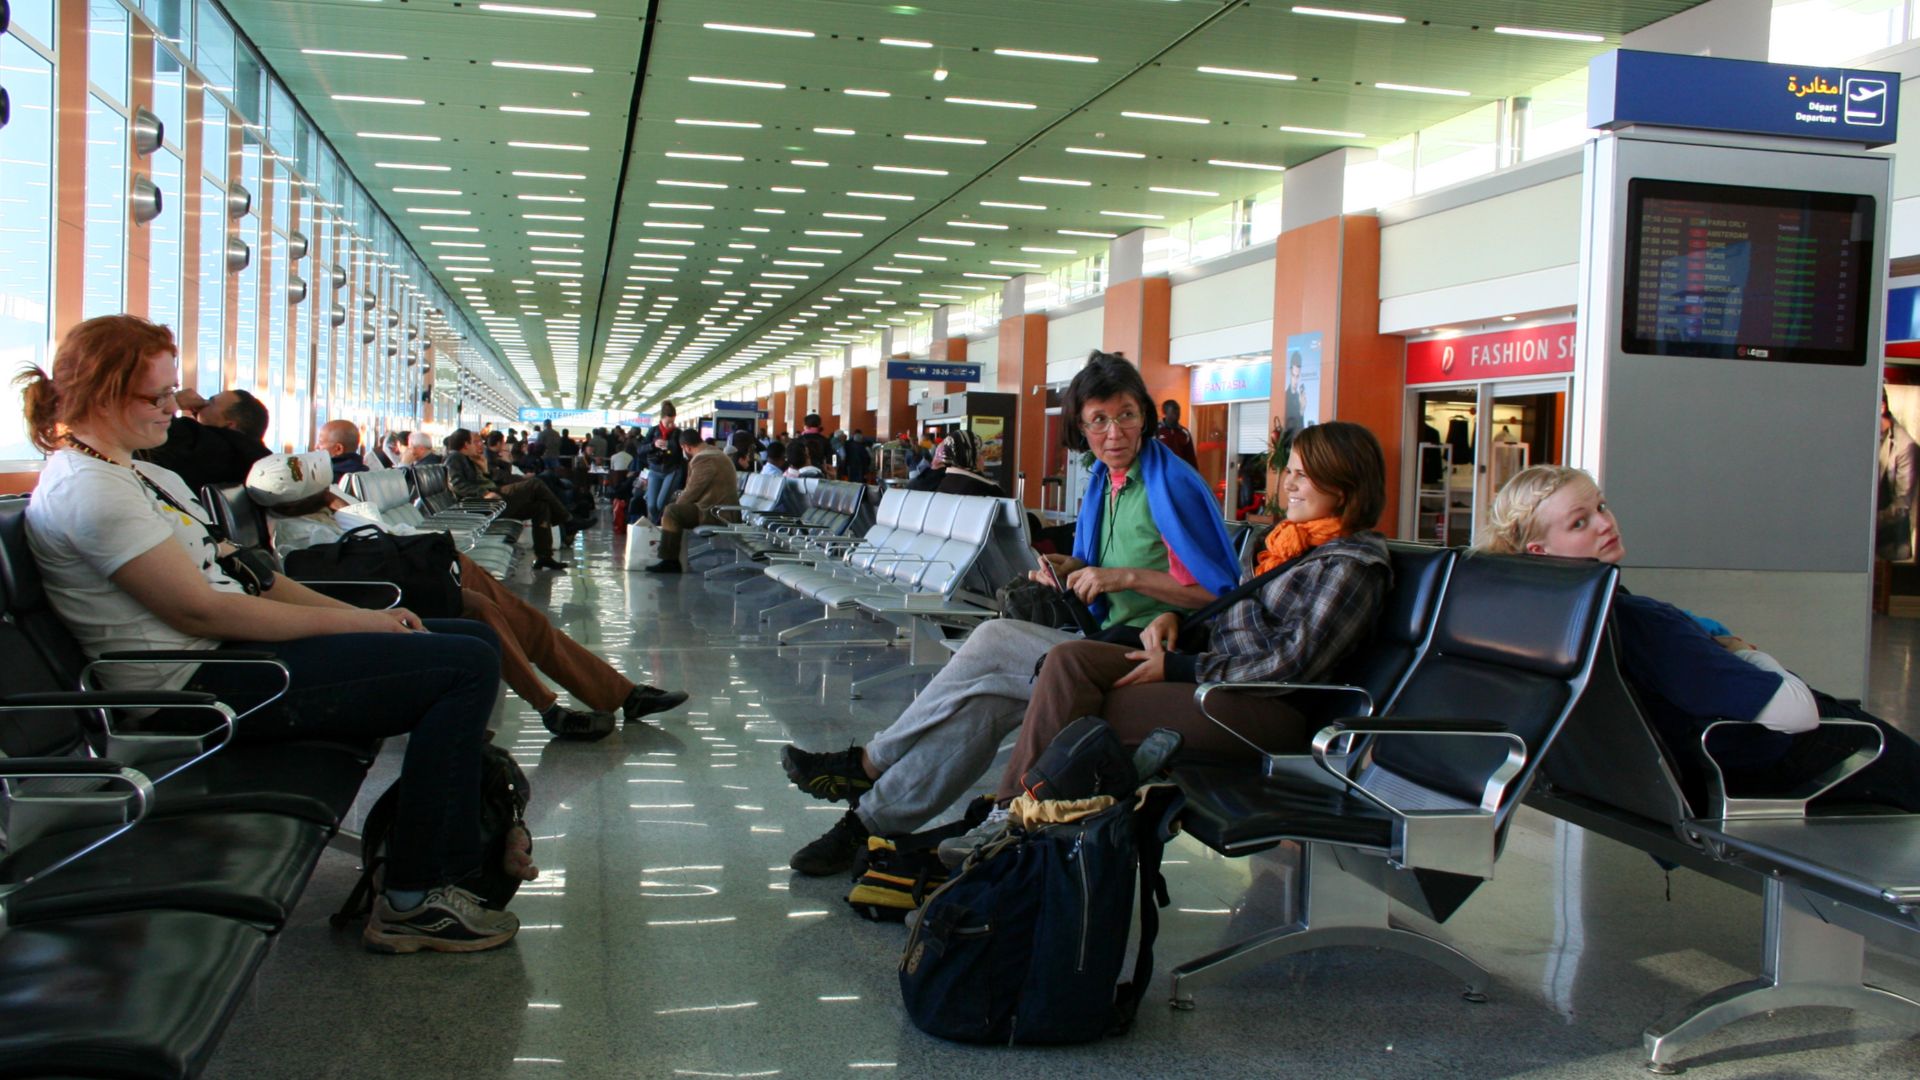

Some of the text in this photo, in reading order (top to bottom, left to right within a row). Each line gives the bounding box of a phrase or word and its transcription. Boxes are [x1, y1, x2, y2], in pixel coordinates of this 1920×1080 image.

[1788, 76, 1838, 97] مغادرة
[1809, 102, 1837, 112] Départ
[1795, 112, 1837, 123] Departure
[1471, 339, 1548, 366] FASHION
[1204, 379, 1247, 392] FANTASIA
